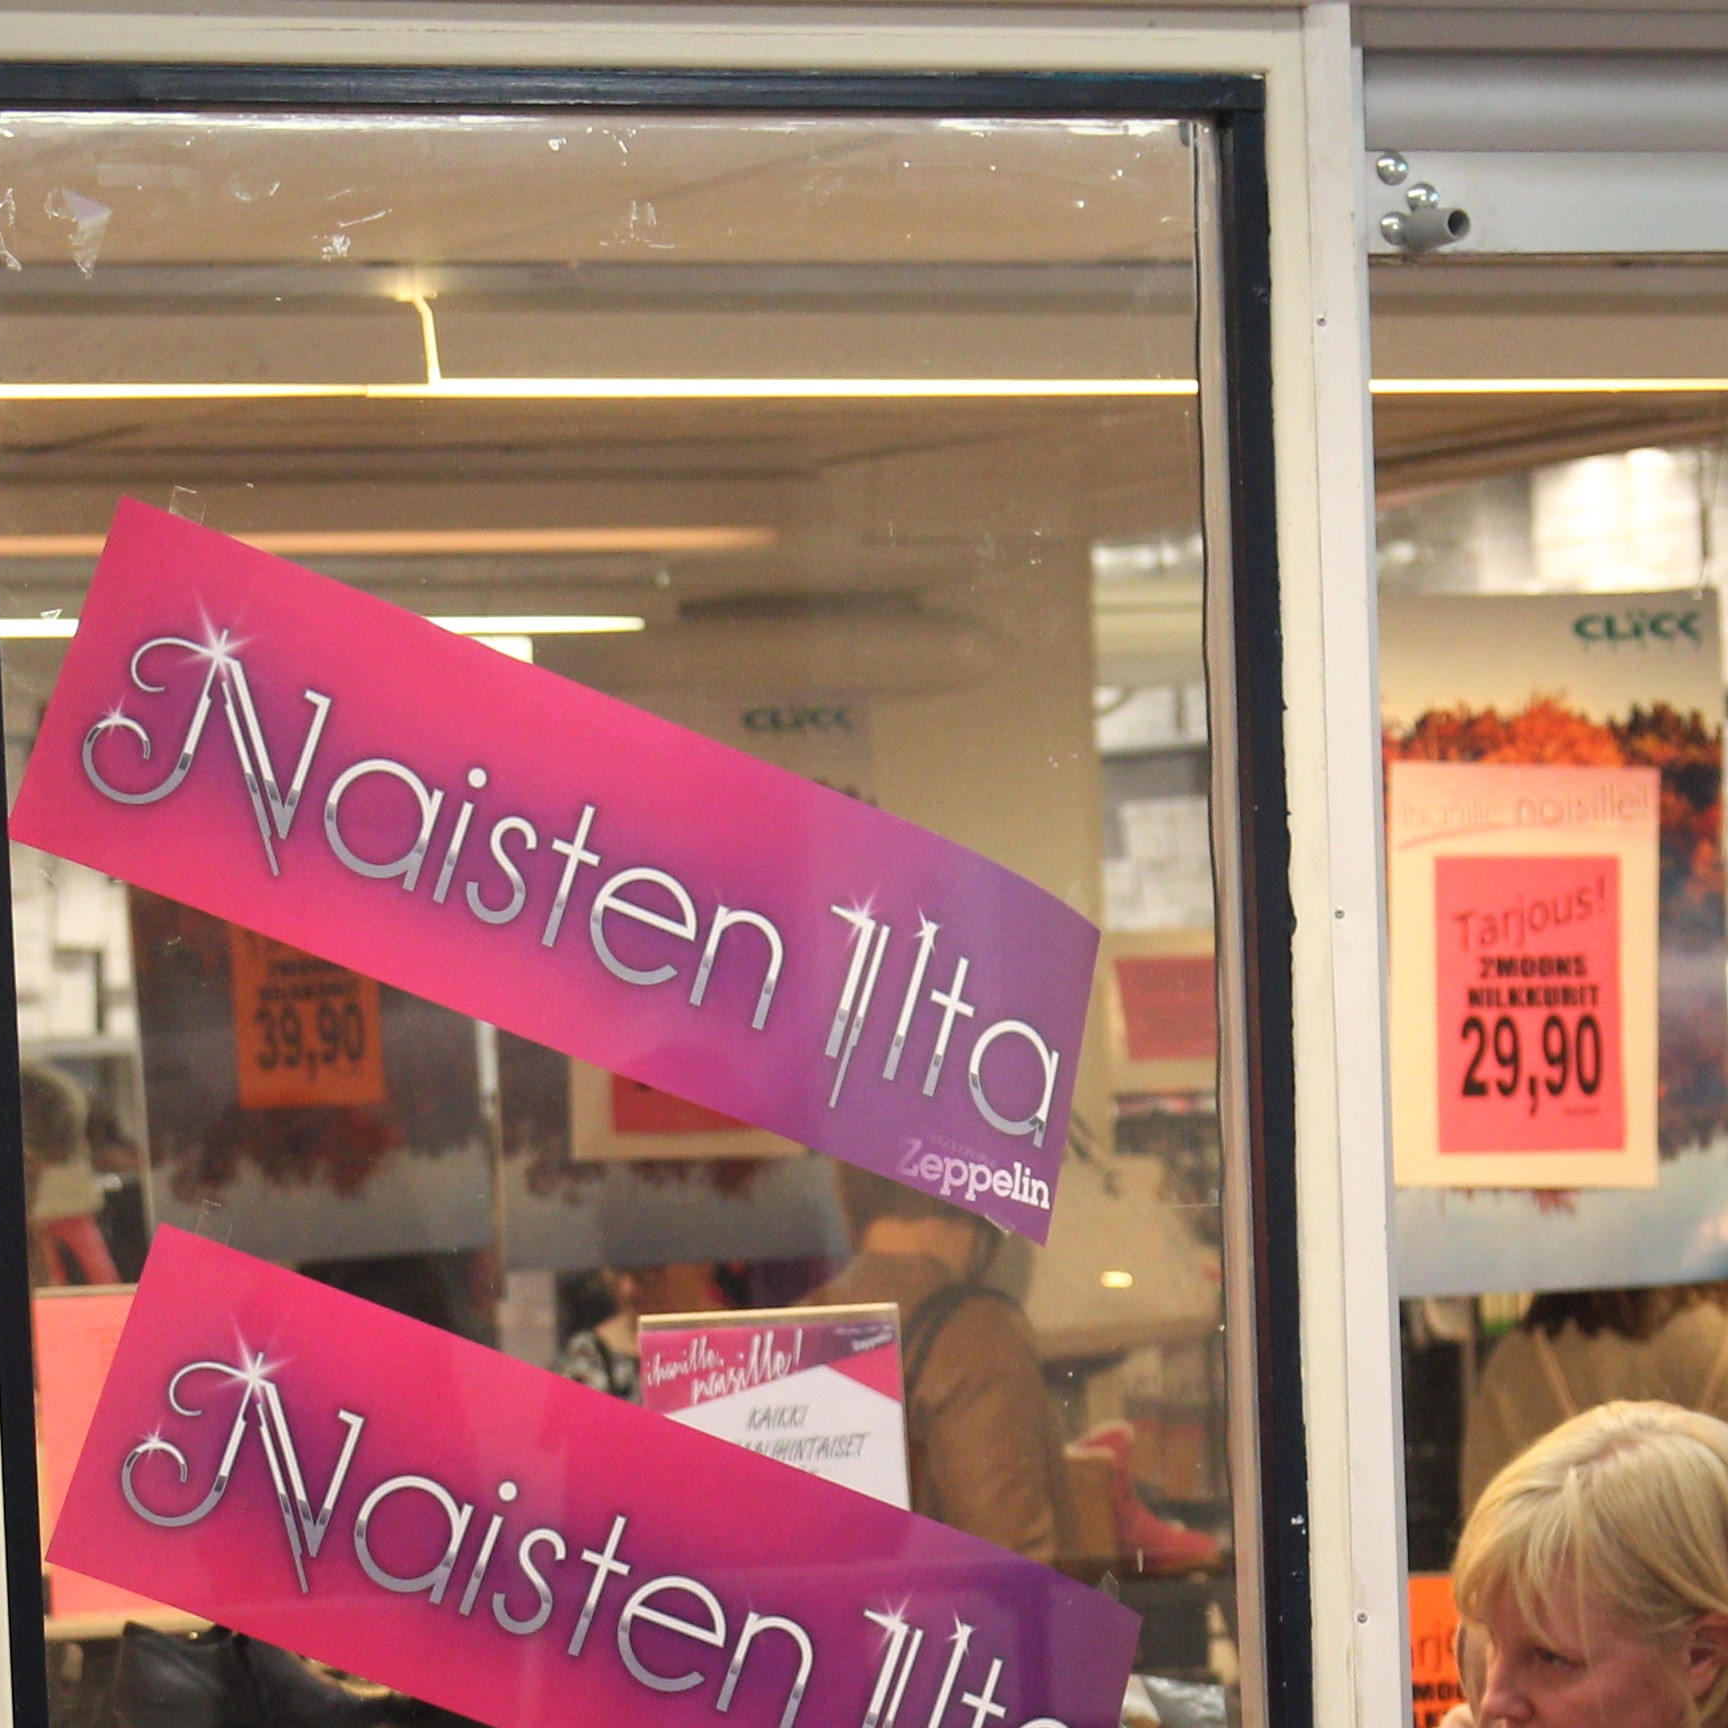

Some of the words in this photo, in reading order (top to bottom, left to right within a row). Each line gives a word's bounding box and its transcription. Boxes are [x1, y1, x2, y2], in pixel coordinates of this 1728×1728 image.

[81, 628, 785, 1031] Naisten
[824, 904, 1060, 1149] Ilta
[1453, 874, 1609, 954] Tarjous!
[254, 1000, 366, 1082] 39,90
[1461, 1015, 1603, 1117] 29,90
[895, 1137, 1052, 1212] Zeppelin
[747, 1404, 810, 1431] KAIKKI
